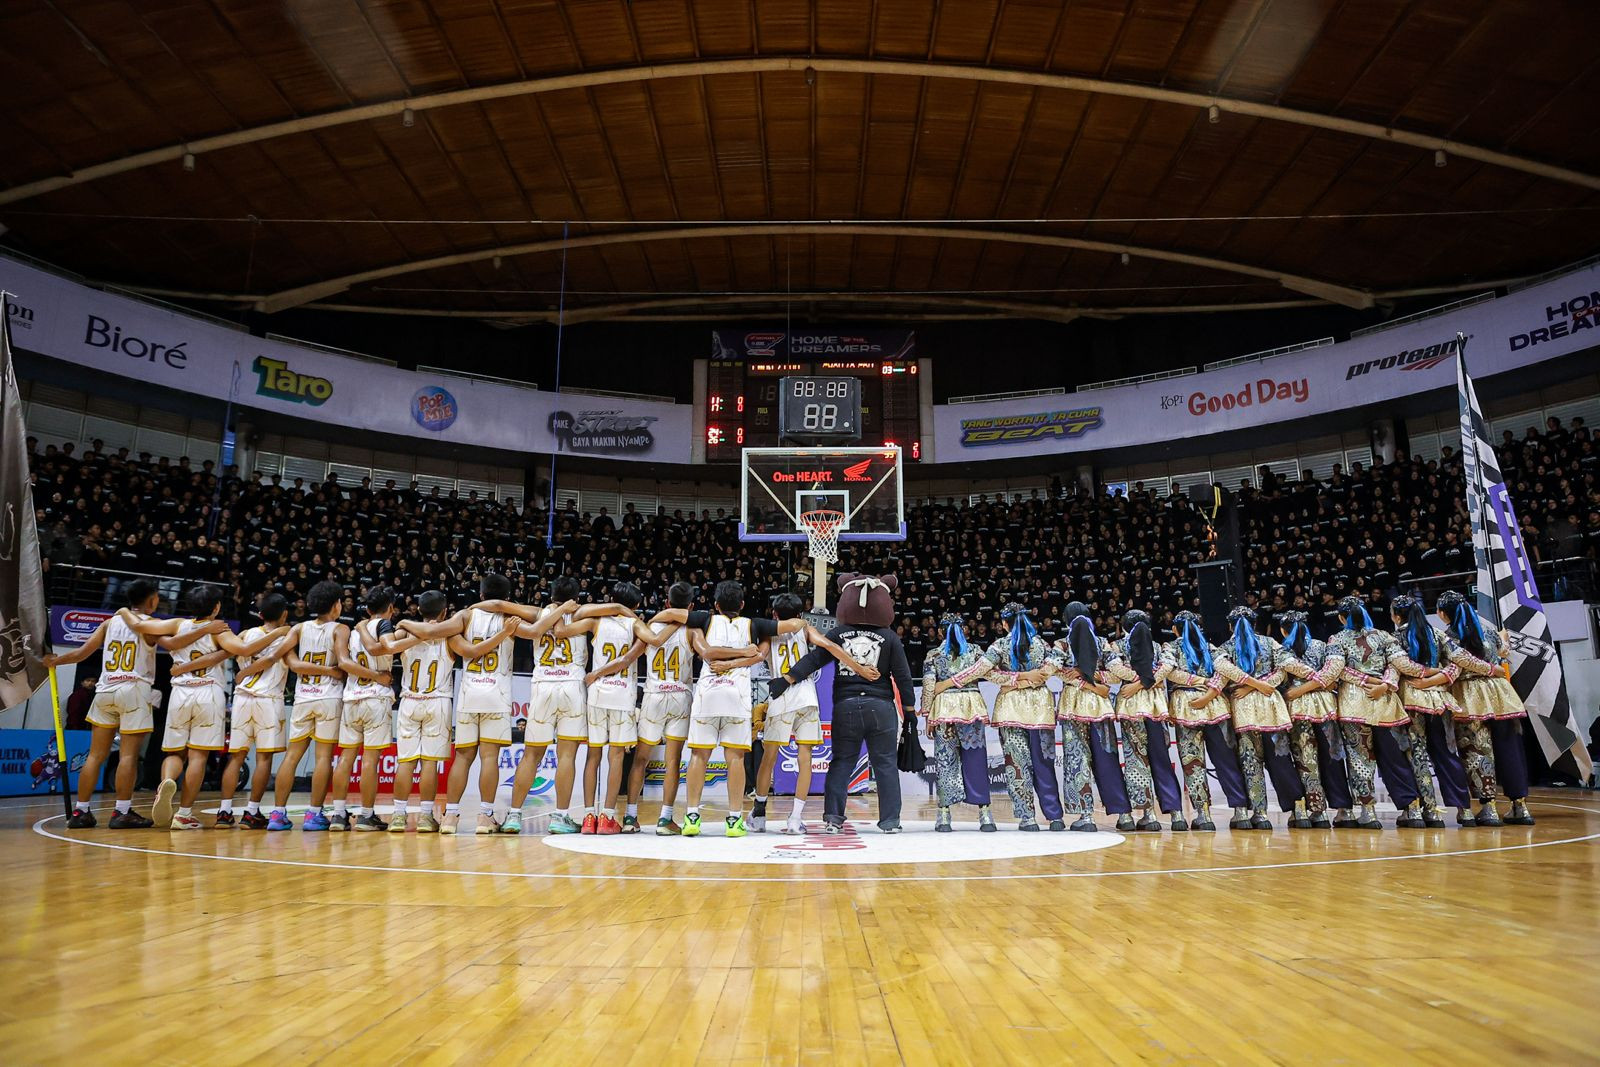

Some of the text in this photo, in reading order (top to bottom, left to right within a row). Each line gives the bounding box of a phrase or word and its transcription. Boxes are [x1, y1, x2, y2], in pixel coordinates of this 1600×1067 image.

[84, 314, 188, 370] Bioré
[791, 336, 838, 345] HOME
[791, 345, 881, 353] DREAMERS
[1346, 336, 1468, 381] proteam
[258, 355, 334, 402] Taro
[1188, 383, 1253, 416] Good
[1257, 378, 1309, 403] Day
[963, 420, 993, 430] YANG
[995, 414, 1034, 427] WORTH
[1052, 412, 1067, 421] YA
[1068, 408, 1100, 419] CUMA
[572, 437, 590, 447] GAYA
[592, 437, 616, 447] MAKIN
[773, 472, 833, 482] One HEART.
[540, 633, 573, 667] 23
[839, 631, 856, 640] FIGHT
[1508, 629, 1557, 663] EST
[105, 640, 137, 672] 30
[302, 650, 328, 684] 17
[652, 647, 680, 681] 44
[778, 642, 801, 675] 21
[409, 658, 438, 693] 11
[0, 748, 30, 760] ULTRA
[1, 762, 27, 774] MILK
